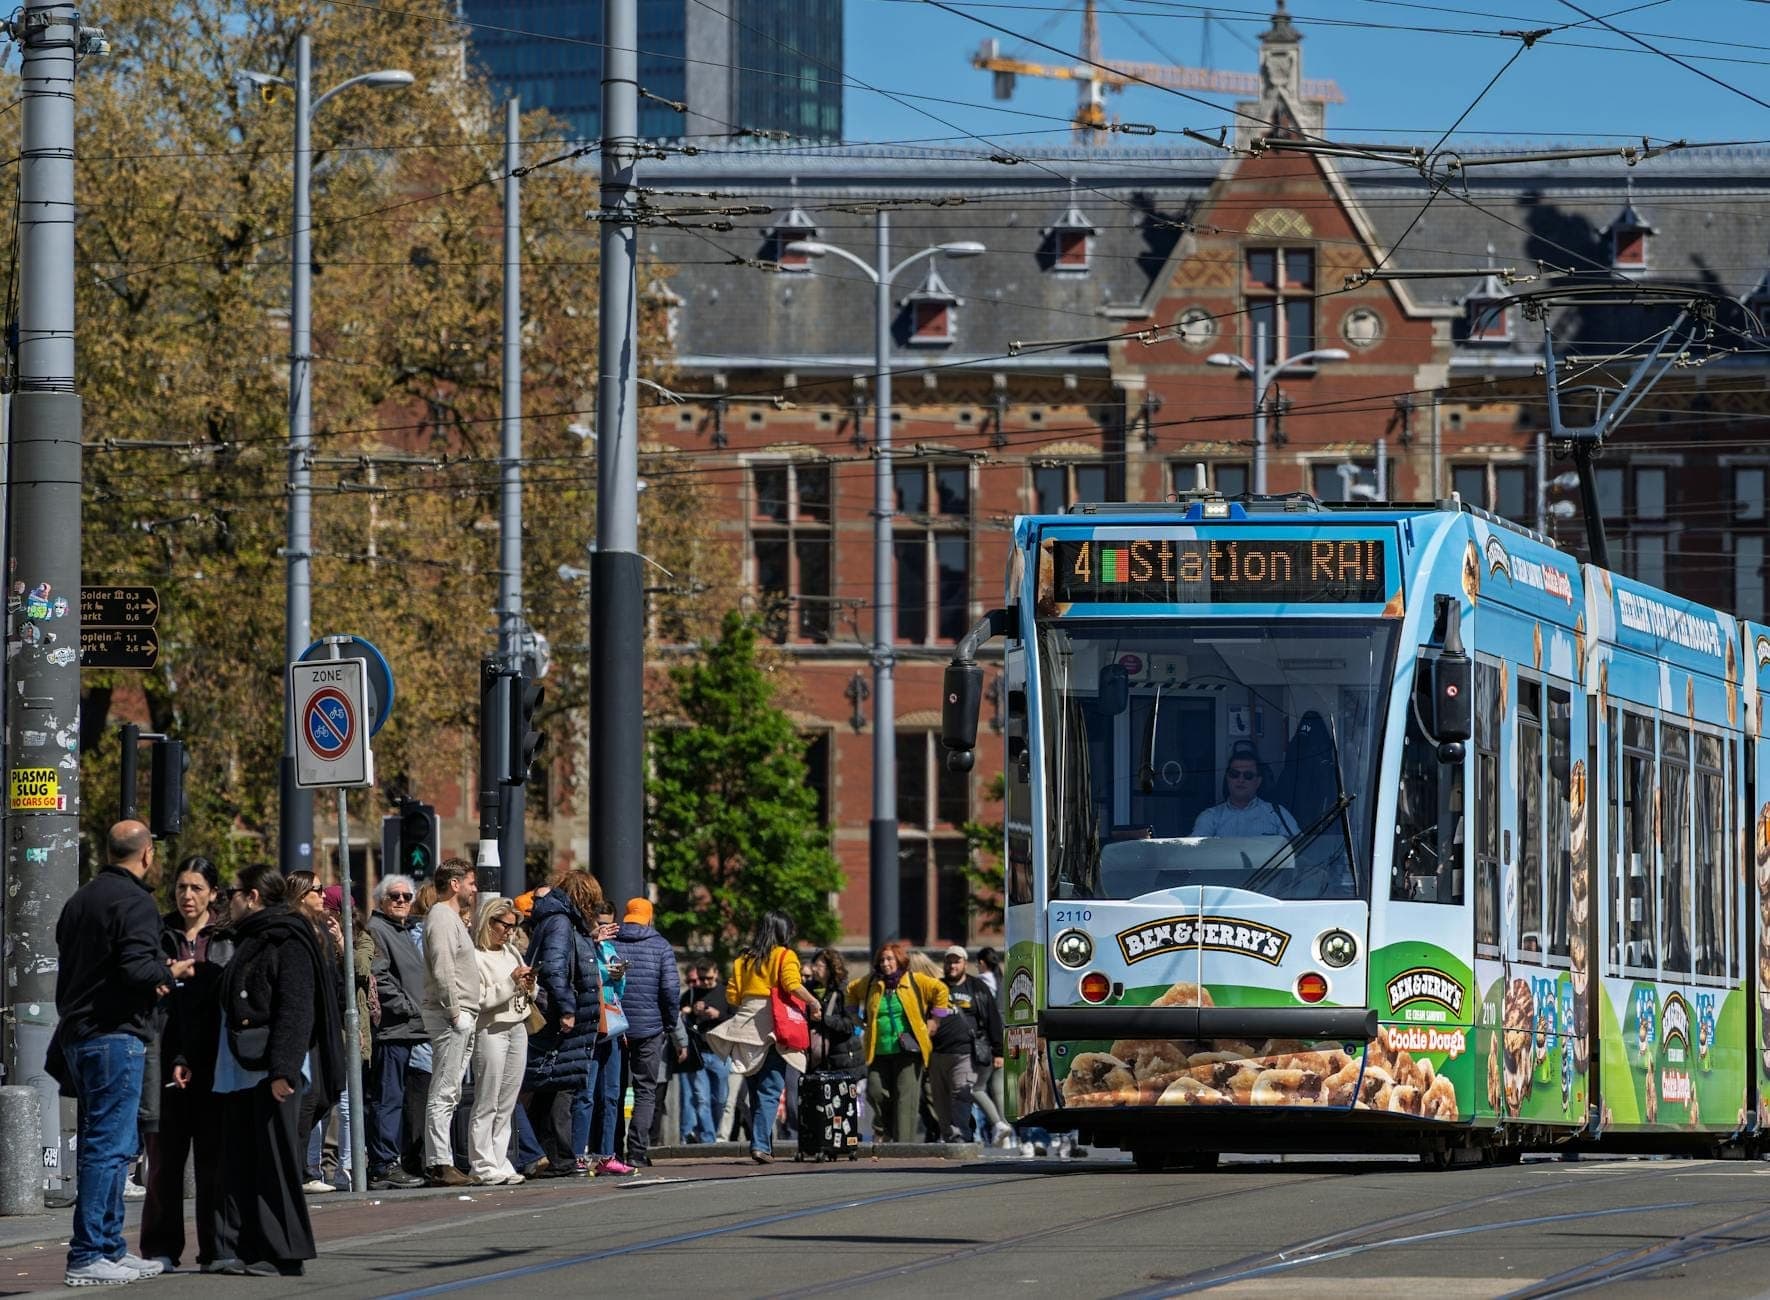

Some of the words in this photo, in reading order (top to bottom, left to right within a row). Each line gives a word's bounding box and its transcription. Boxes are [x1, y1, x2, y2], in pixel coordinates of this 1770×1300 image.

[1074, 541, 1091, 583] 4
[1131, 539, 1291, 582] Station
[1312, 540, 1376, 581] RAI
[81, 591, 112, 600] Solder
[126, 592, 140, 600] 0,3
[126, 603, 140, 611] 0,4
[80, 633, 112, 643] oplein
[312, 669, 342, 682] ZONE
[12, 770, 56, 783] PLASMA
[17, 783, 48, 796] SLUG
[22, 797, 42, 807] CARS
[43, 797, 56, 806] GO
[1056, 910, 1092, 922] 2110
[1482, 1002, 1496, 1025] 2110
[1388, 1026, 1428, 1051] Cookie
[1428, 1026, 1466, 1059] Dough
